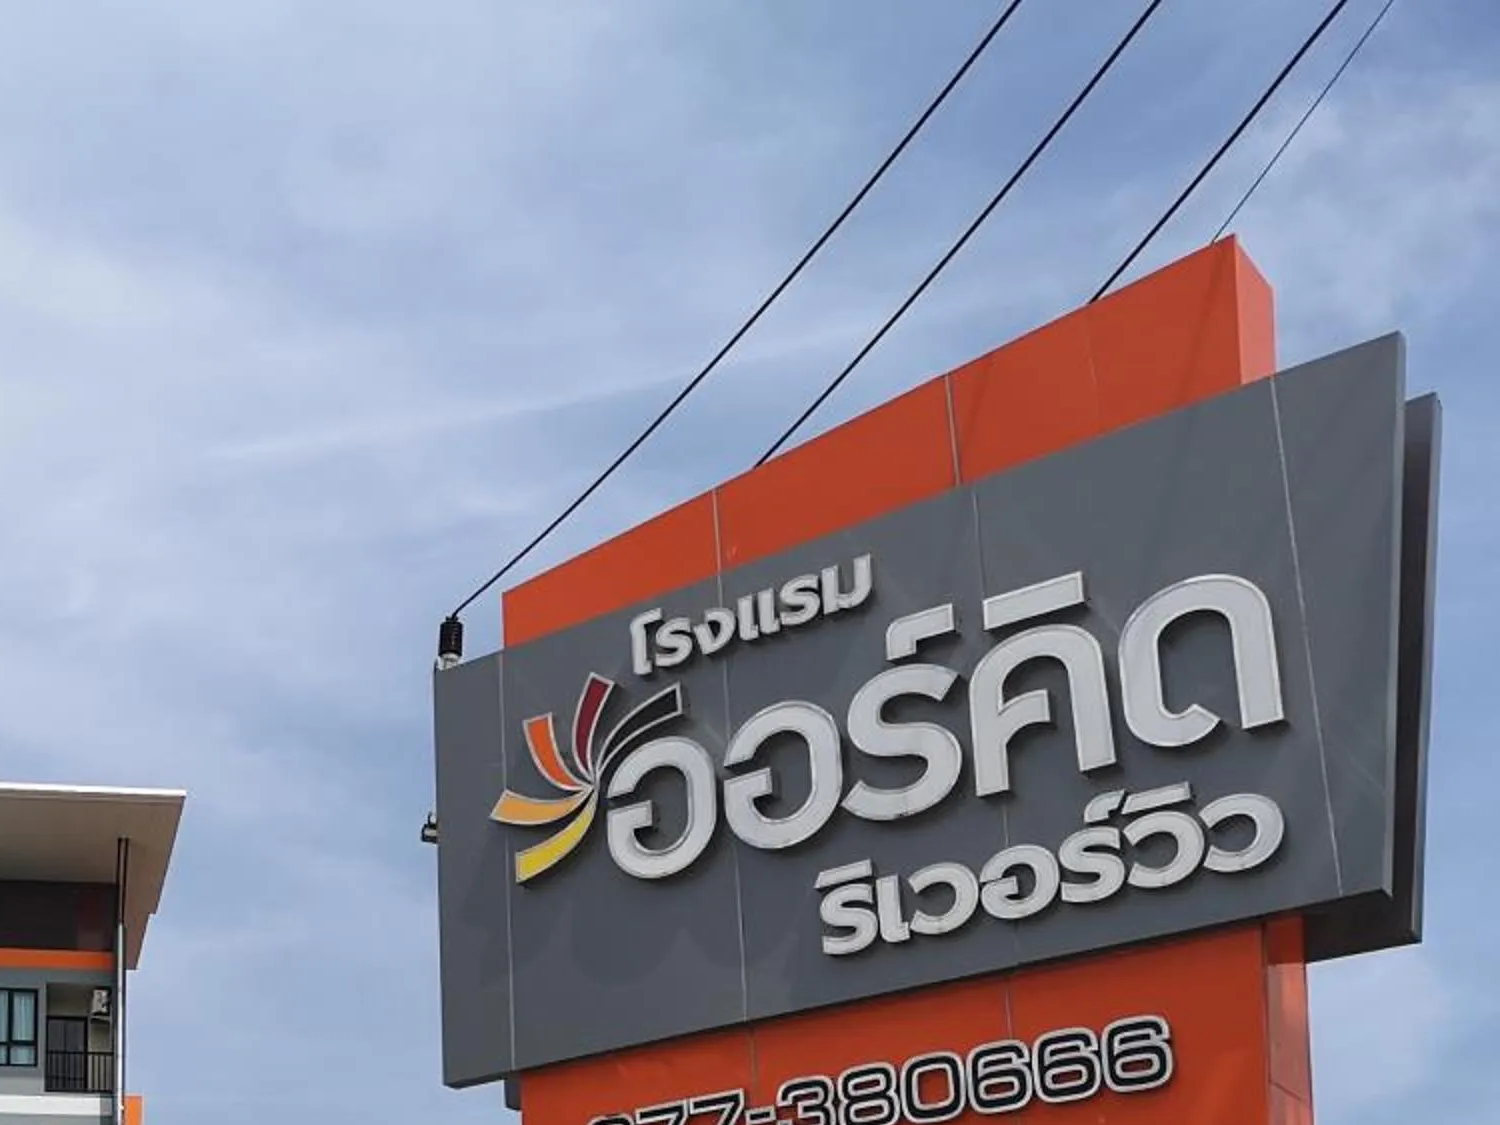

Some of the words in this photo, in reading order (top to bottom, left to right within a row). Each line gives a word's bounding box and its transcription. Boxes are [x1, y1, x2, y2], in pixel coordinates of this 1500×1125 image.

[630, 553, 874, 675] โรงแรม
[605, 572, 1286, 880] ออร์คิด
